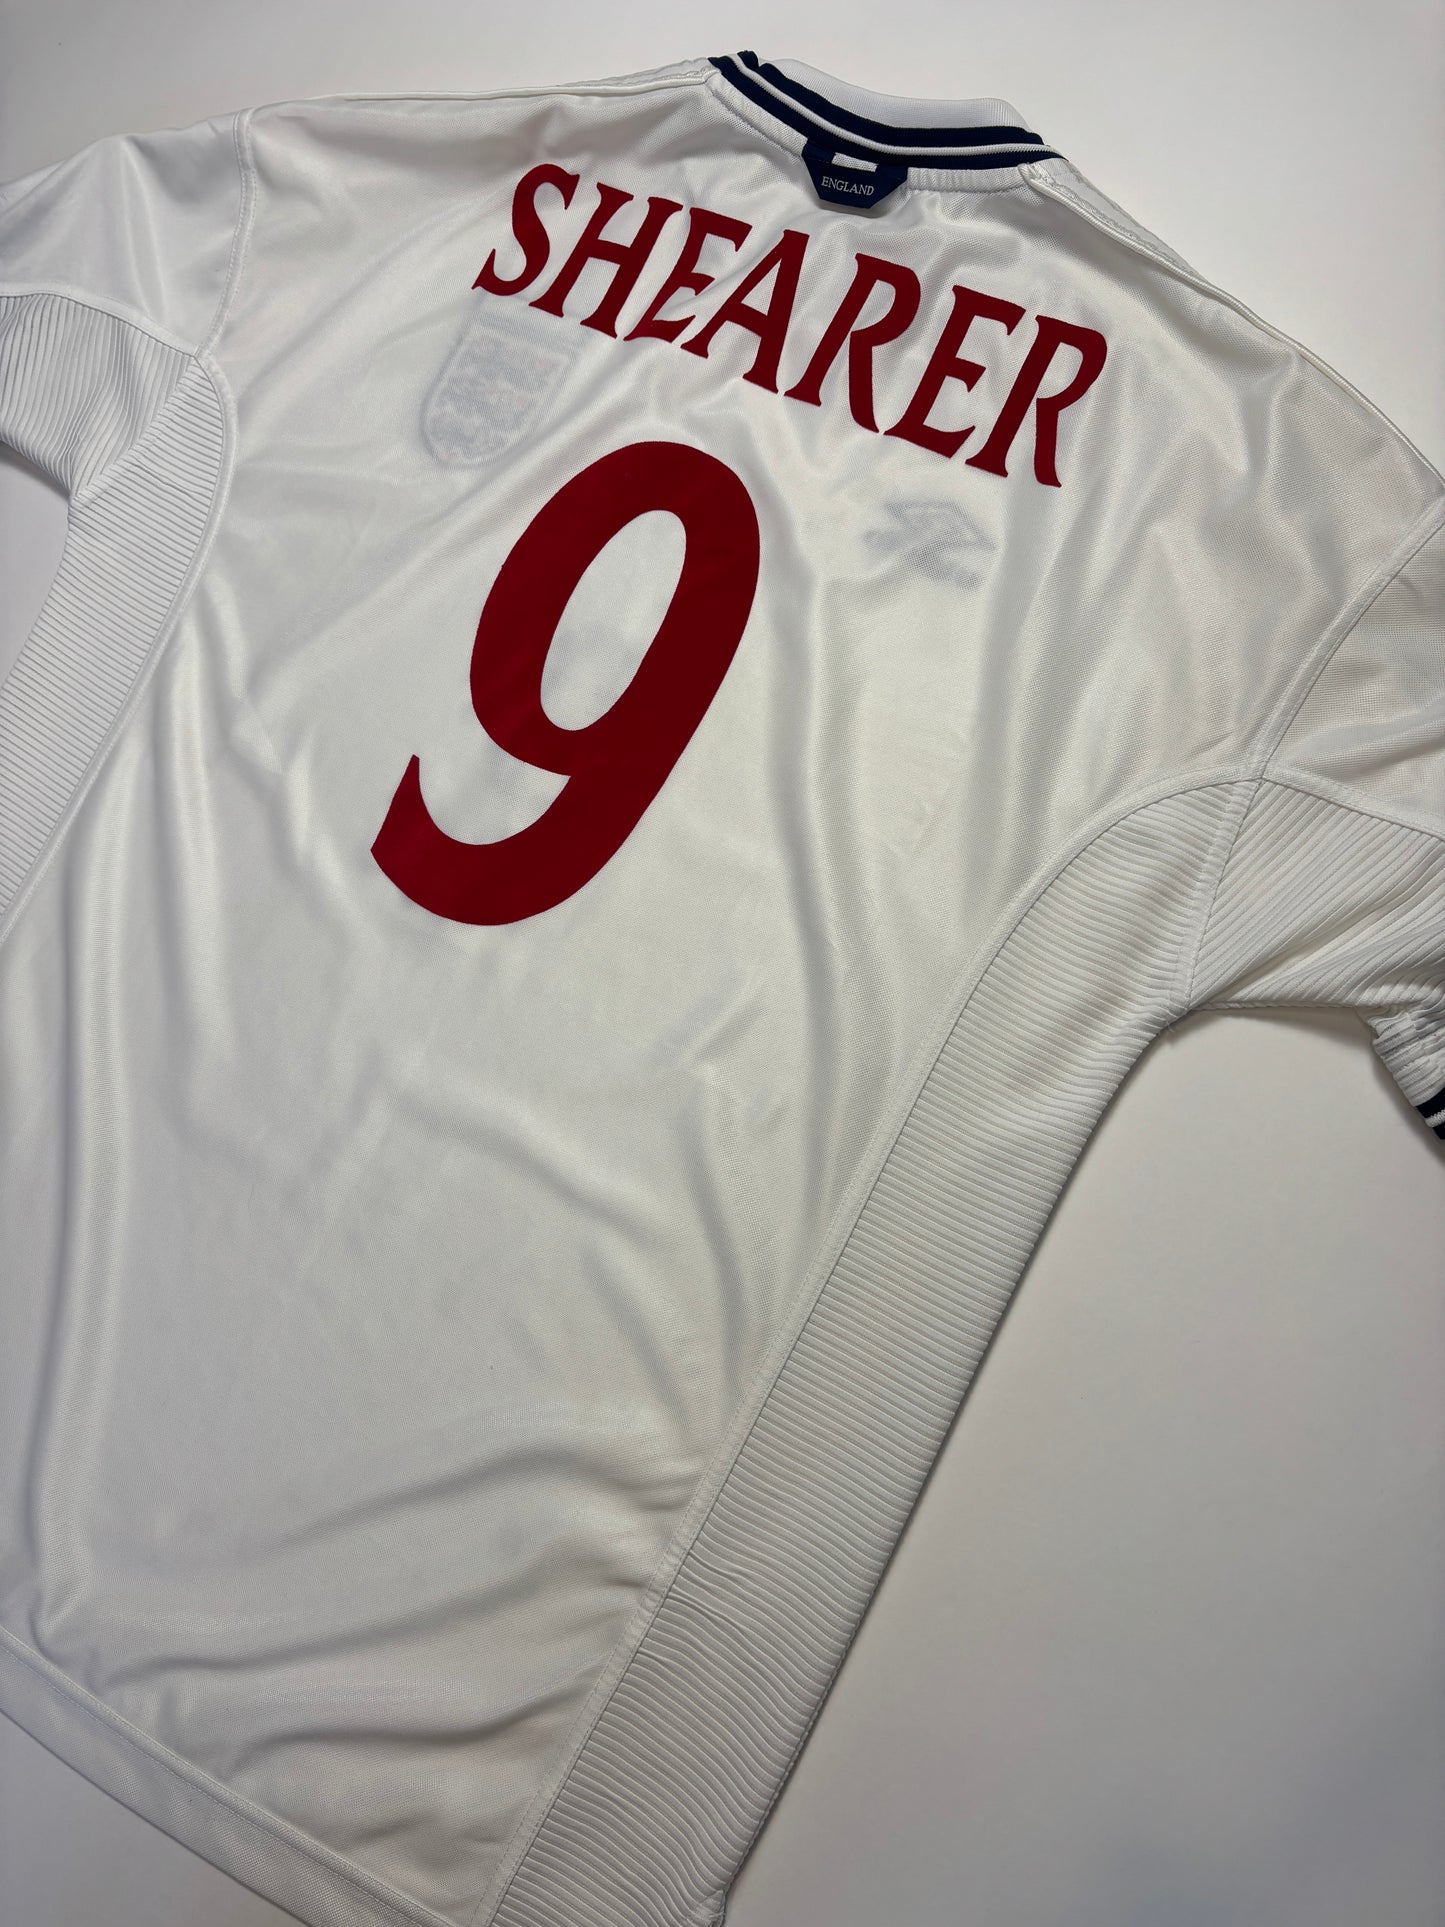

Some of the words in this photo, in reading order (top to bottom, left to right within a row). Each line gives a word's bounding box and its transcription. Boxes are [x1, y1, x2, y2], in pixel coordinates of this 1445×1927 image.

[472, 164, 1107, 486] SHEARER
[821, 176, 874, 196] ENGLAND
[371, 441, 759, 925] 9
